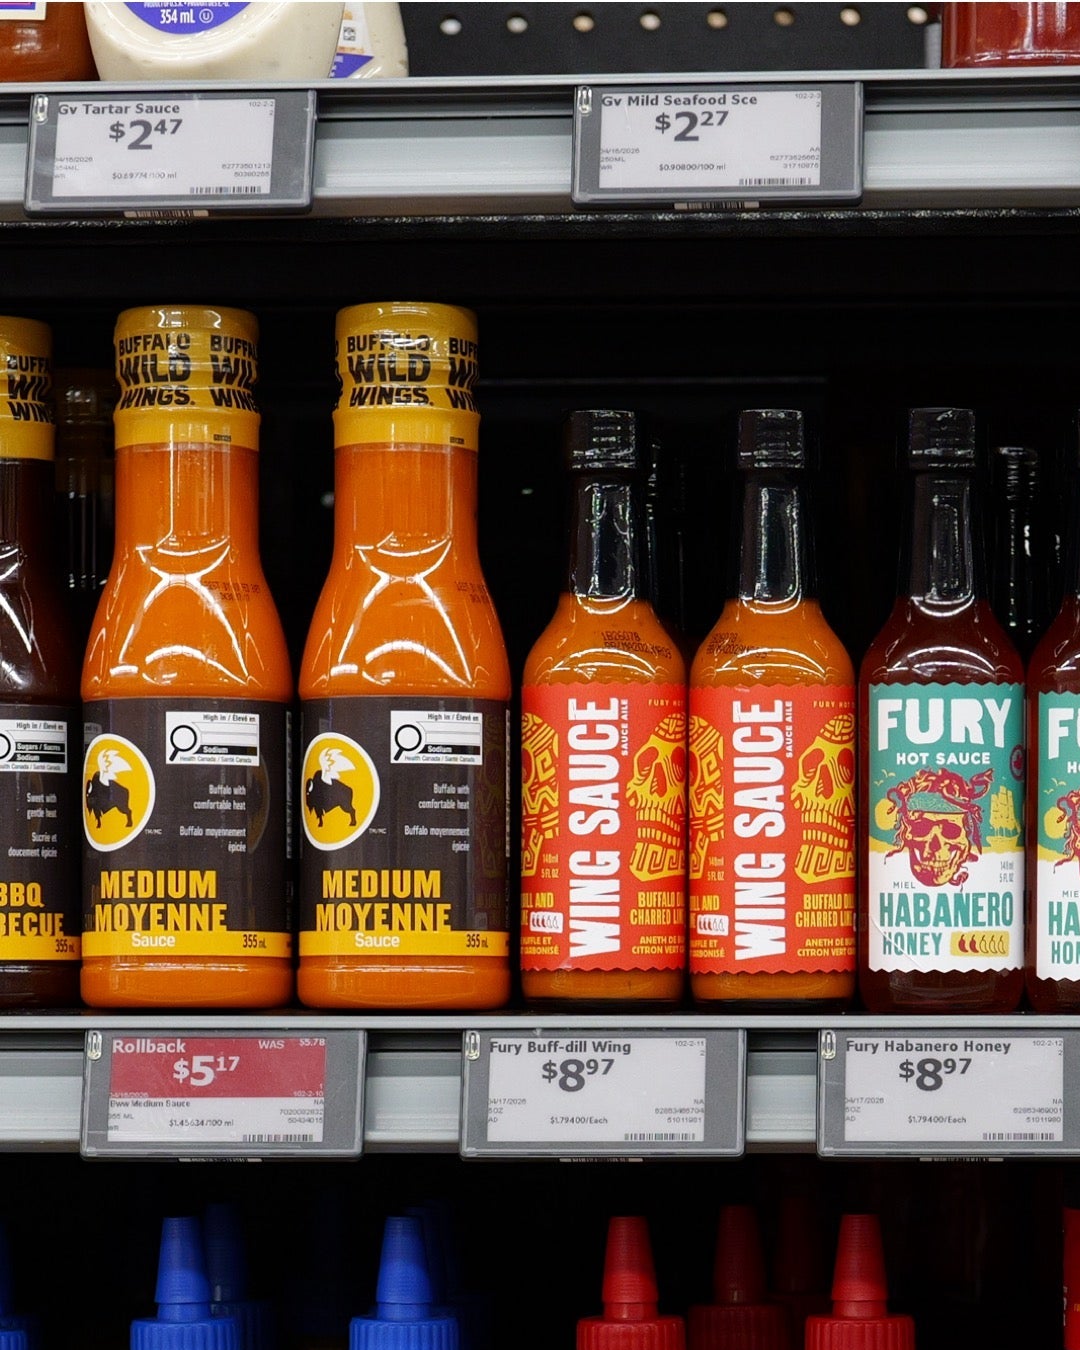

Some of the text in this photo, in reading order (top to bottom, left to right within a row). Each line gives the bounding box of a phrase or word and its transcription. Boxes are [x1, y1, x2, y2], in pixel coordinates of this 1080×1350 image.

[160, 9, 195, 24] 354 mL
[58, 103, 180, 115] Gv Tartar Sauce
[601, 95, 757, 107] Gv Mild Seafood Sce
[348, 354, 431, 382] WILD
[878, 698, 1012, 751] FURY
[896, 752, 990, 765] HOT SAUCE
[567, 697, 621, 957] WING SAUCE
[101, 870, 216, 898] MEDIUM
[95, 903, 227, 931] MOYENNE
[879, 892, 1014, 927] HABANERO
[131, 933, 176, 947] Sauce
[883, 932, 942, 955] HONEY
[112, 1038, 325, 1054] Rollback WAS $5.78
[490, 1040, 631, 1055] Fury Buff-dill Wing
[846, 1040, 1011, 1054] Fury Habanero Honey
